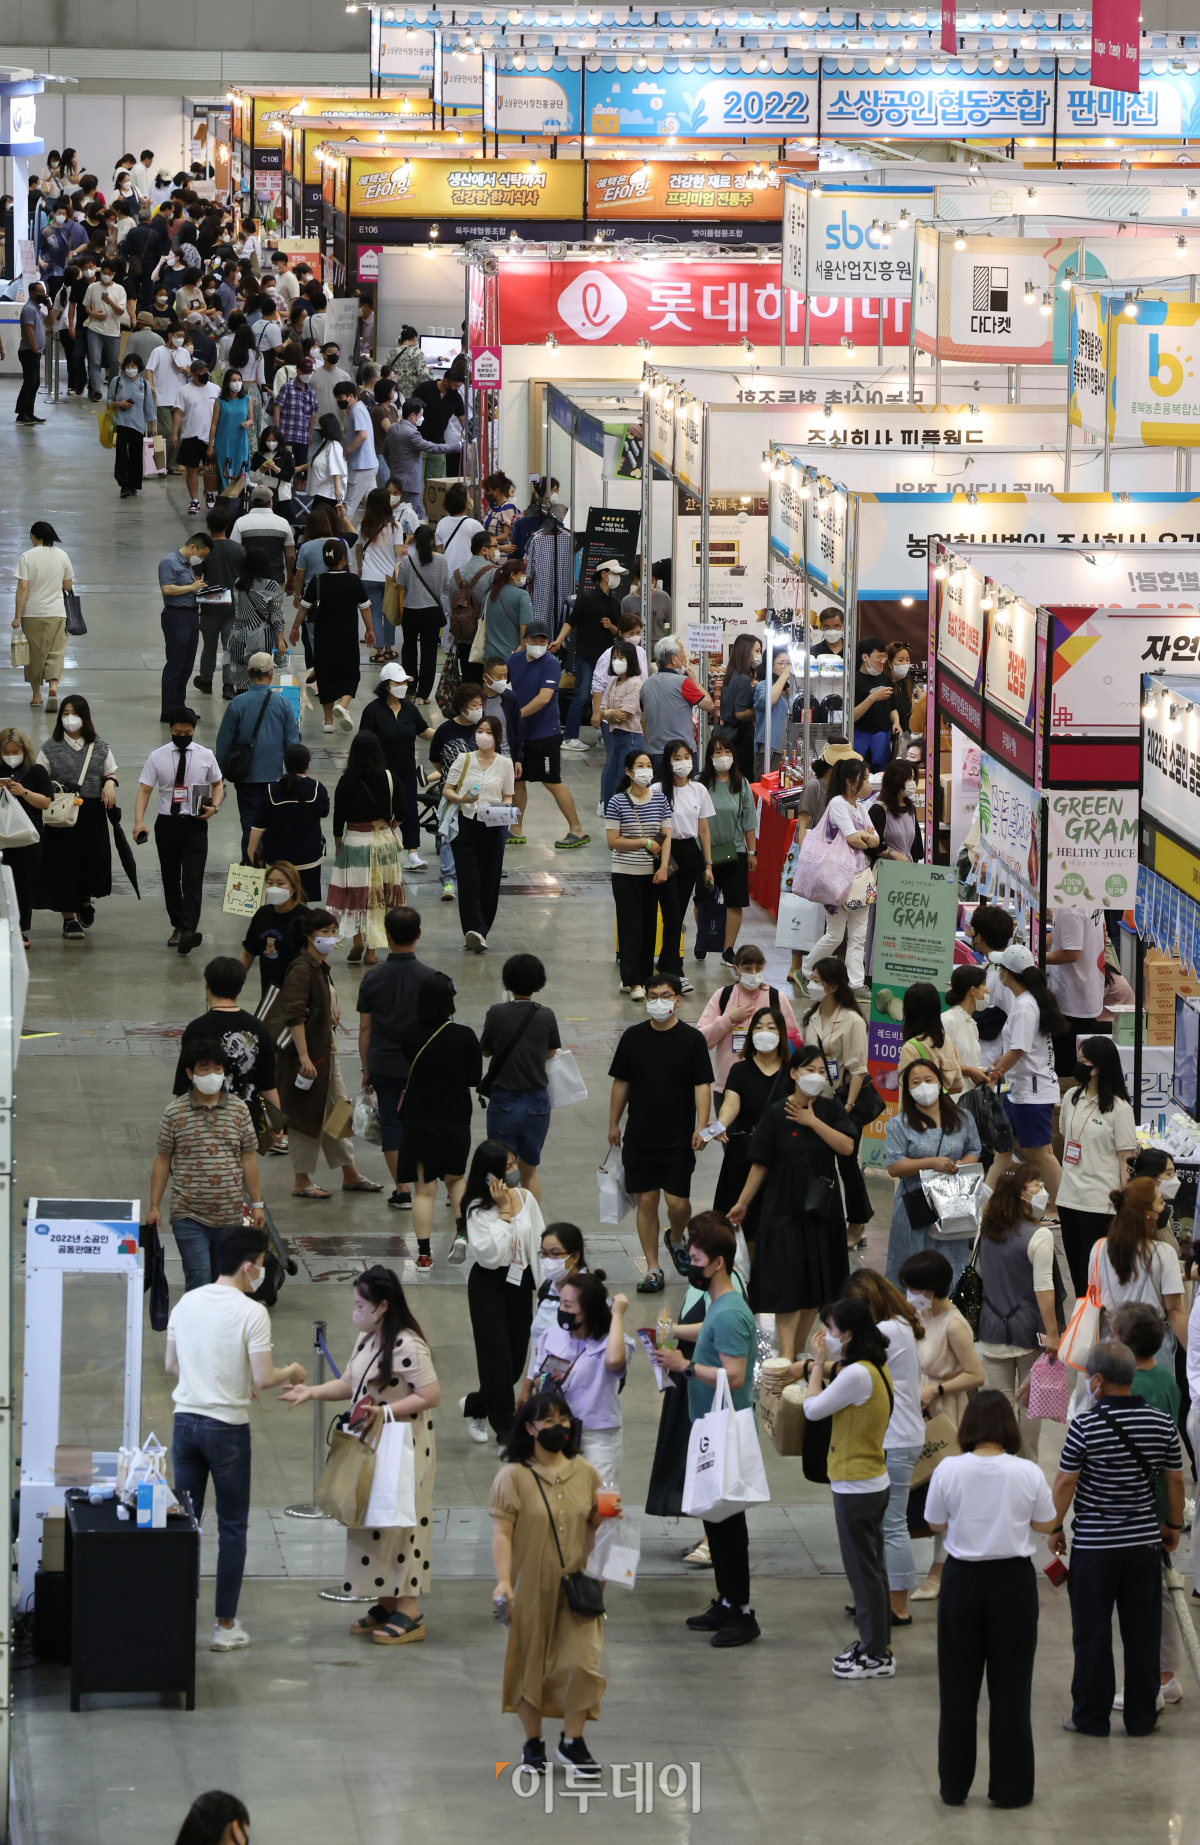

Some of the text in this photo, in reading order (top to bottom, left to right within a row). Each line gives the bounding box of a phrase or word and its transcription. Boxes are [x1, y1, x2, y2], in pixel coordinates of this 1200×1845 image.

[724, 88, 1158, 126] 2022 소상공인협동조합 판매전
[448, 172, 546, 188] 생산에서 식탁까지
[669, 174, 706, 190] 건강한
[707, 174, 732, 189] 재료
[452, 189, 540, 206] 건강한 한끼식사
[666, 192, 715, 206] 프리미엄
[716, 192, 754, 207] 전통주
[358, 226, 378, 234] E106
[815, 260, 912, 282] 서울산업진흥원
[971, 316, 1012, 334] 다다켓
[1141, 635, 1200, 662] 자연
[1148, 728, 1168, 776] 2022년
[1168, 740, 1189, 790] 소공인
[1053, 796, 1124, 818] GREEN
[1064, 818, 1138, 846] GRAM
[1056, 847, 1136, 860] HELTHY JUICE
[930, 872, 945, 881] FDA
[1063, 878, 1083, 886] 100%
[887, 890, 930, 908] GREEN
[893, 907, 938, 931] GRAM
[874, 1043, 902, 1058] 100
[50, 1234, 109, 1244] 2022년 소공인
[58, 1245, 101, 1255] 공동판매전
